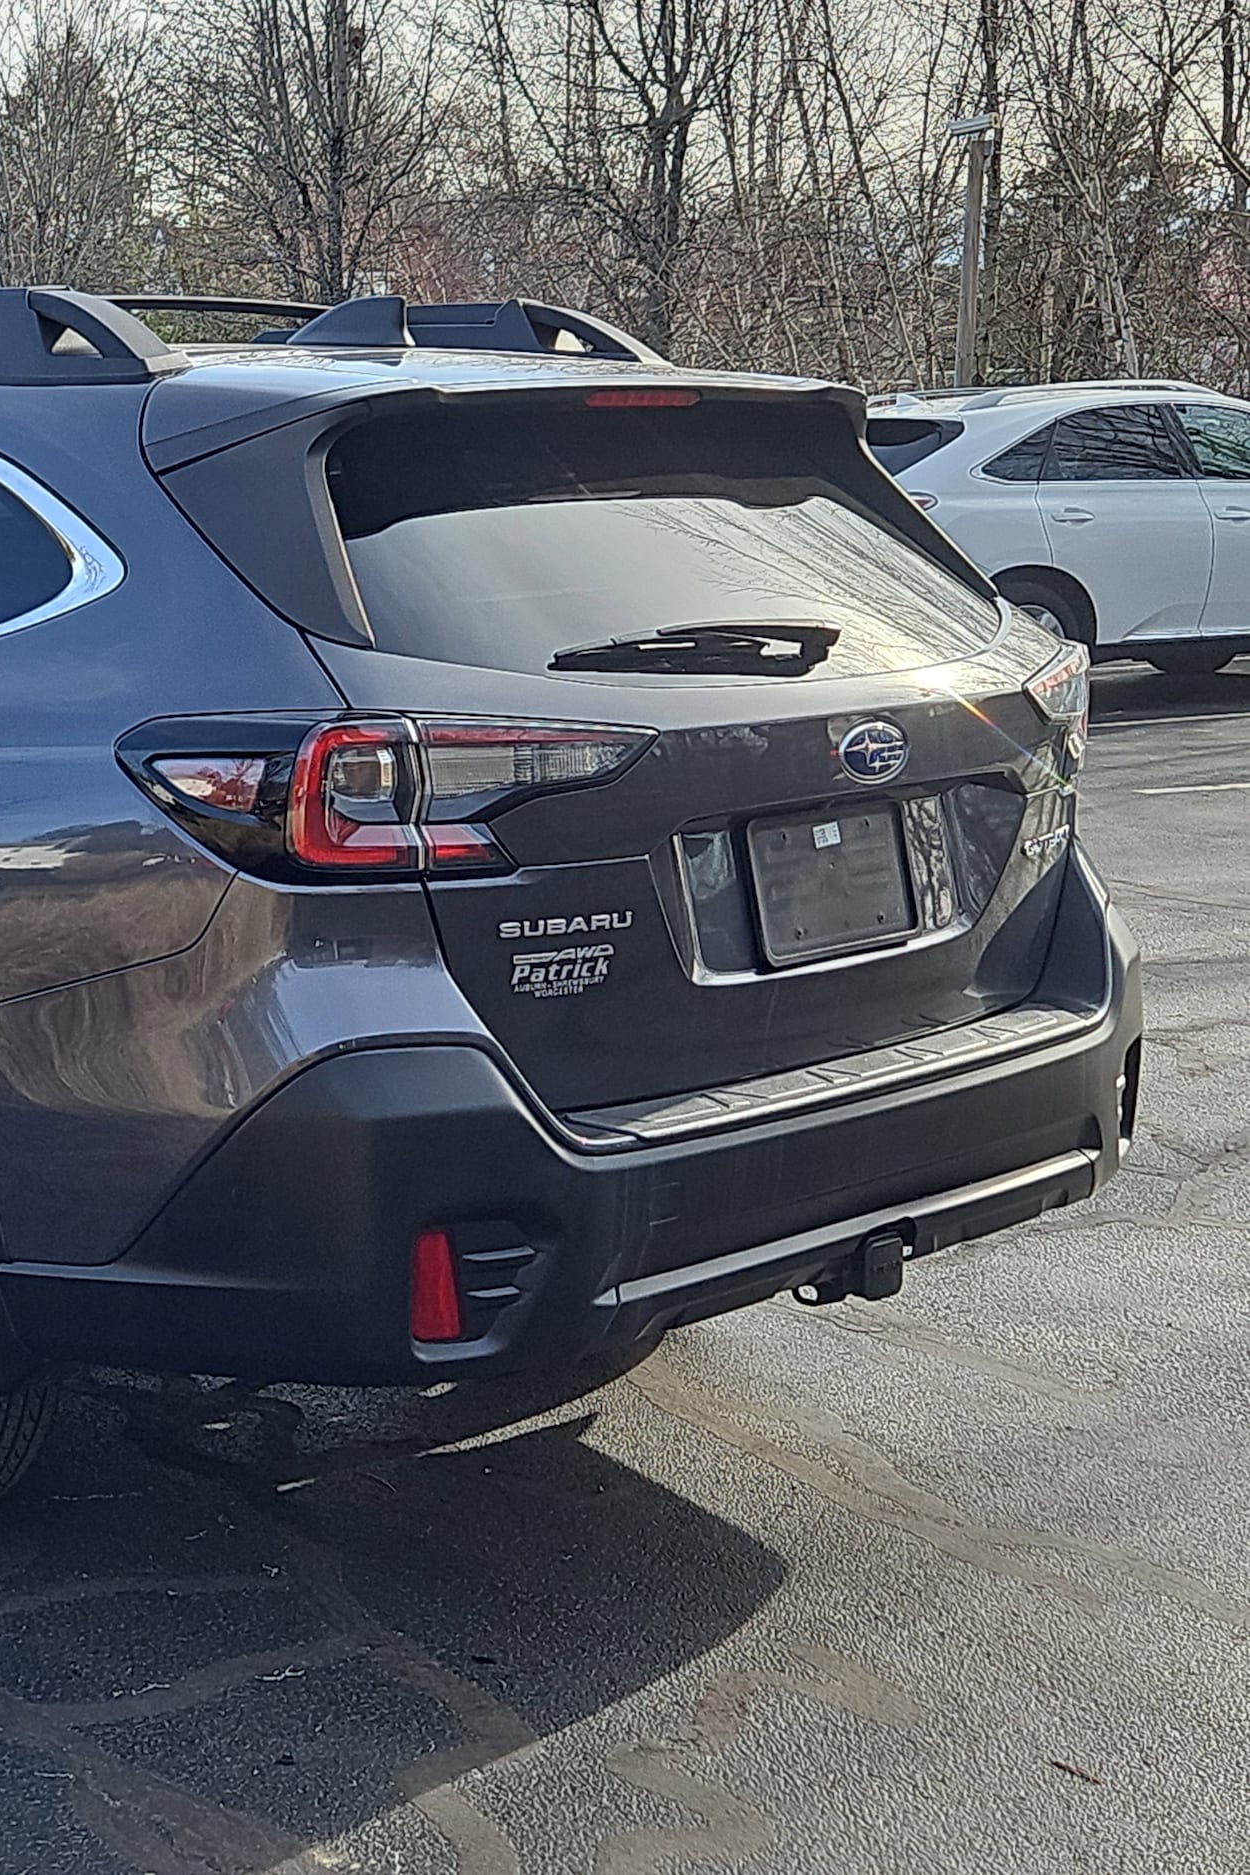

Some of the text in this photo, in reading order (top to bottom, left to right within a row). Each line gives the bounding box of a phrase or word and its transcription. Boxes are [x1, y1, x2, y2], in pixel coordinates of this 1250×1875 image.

[498, 910, 634, 939] SUBARU
[553, 943, 615, 963] AWD
[510, 956, 610, 985] Patrick
[533, 985, 585, 998] WORCESTER
